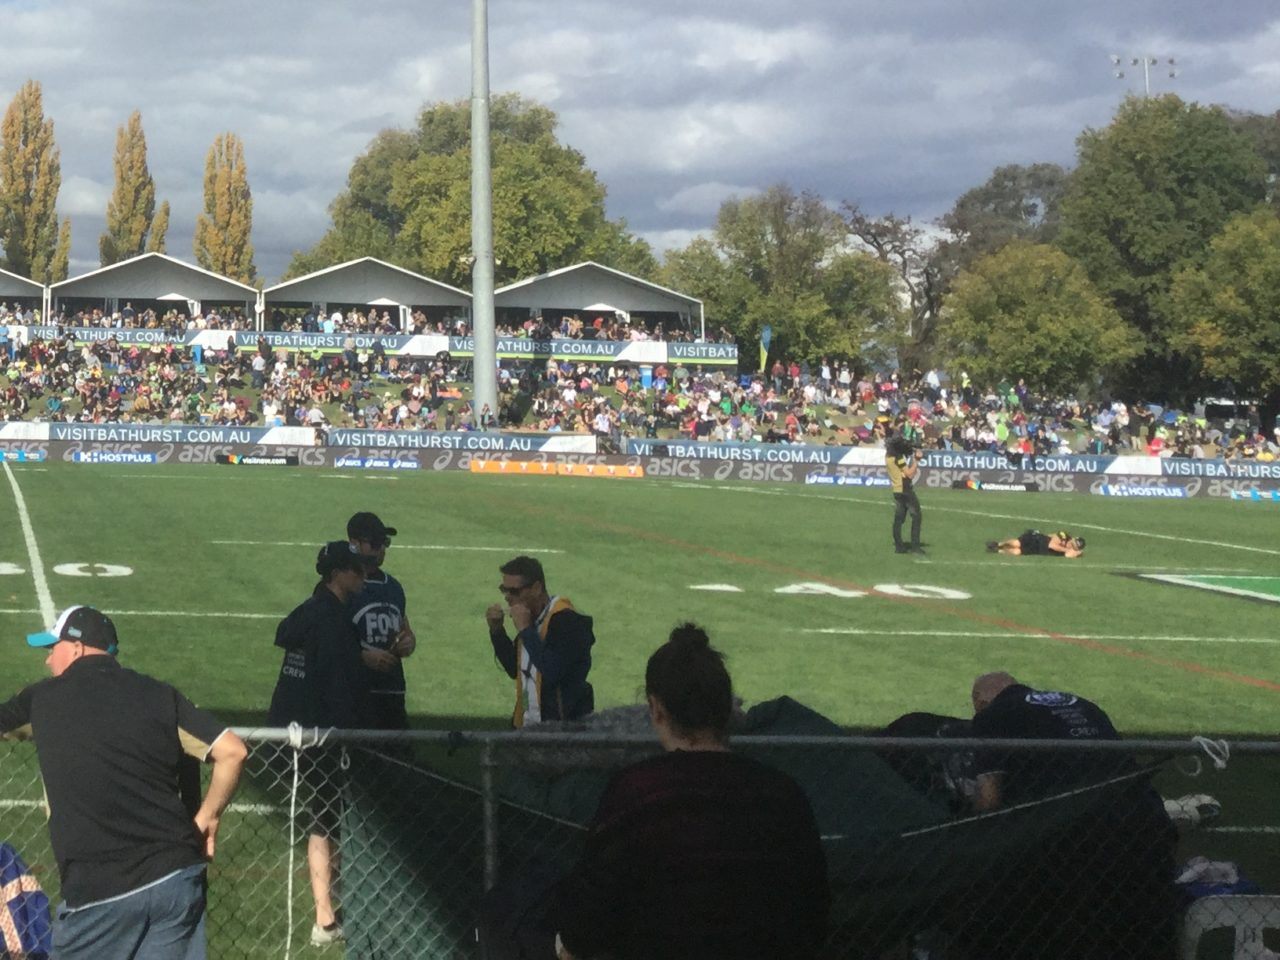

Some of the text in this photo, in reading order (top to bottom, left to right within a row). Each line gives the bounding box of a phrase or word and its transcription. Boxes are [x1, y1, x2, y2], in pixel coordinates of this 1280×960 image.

[455, 340, 614, 354] VISATHURST.COM.AU
[674, 346, 738, 357] VISITBAT
[56, 427, 250, 443] VISITBATHURST.COM.AU
[335, 432, 531, 450] VISITBATHURST.COM.AU
[99, 453, 152, 462] HOSTPLUS
[633, 443, 831, 464] VITBATHURST.COM.AU
[1128, 486, 1183, 497] HOSTPLUS
[283, 665, 306, 679] CREW
